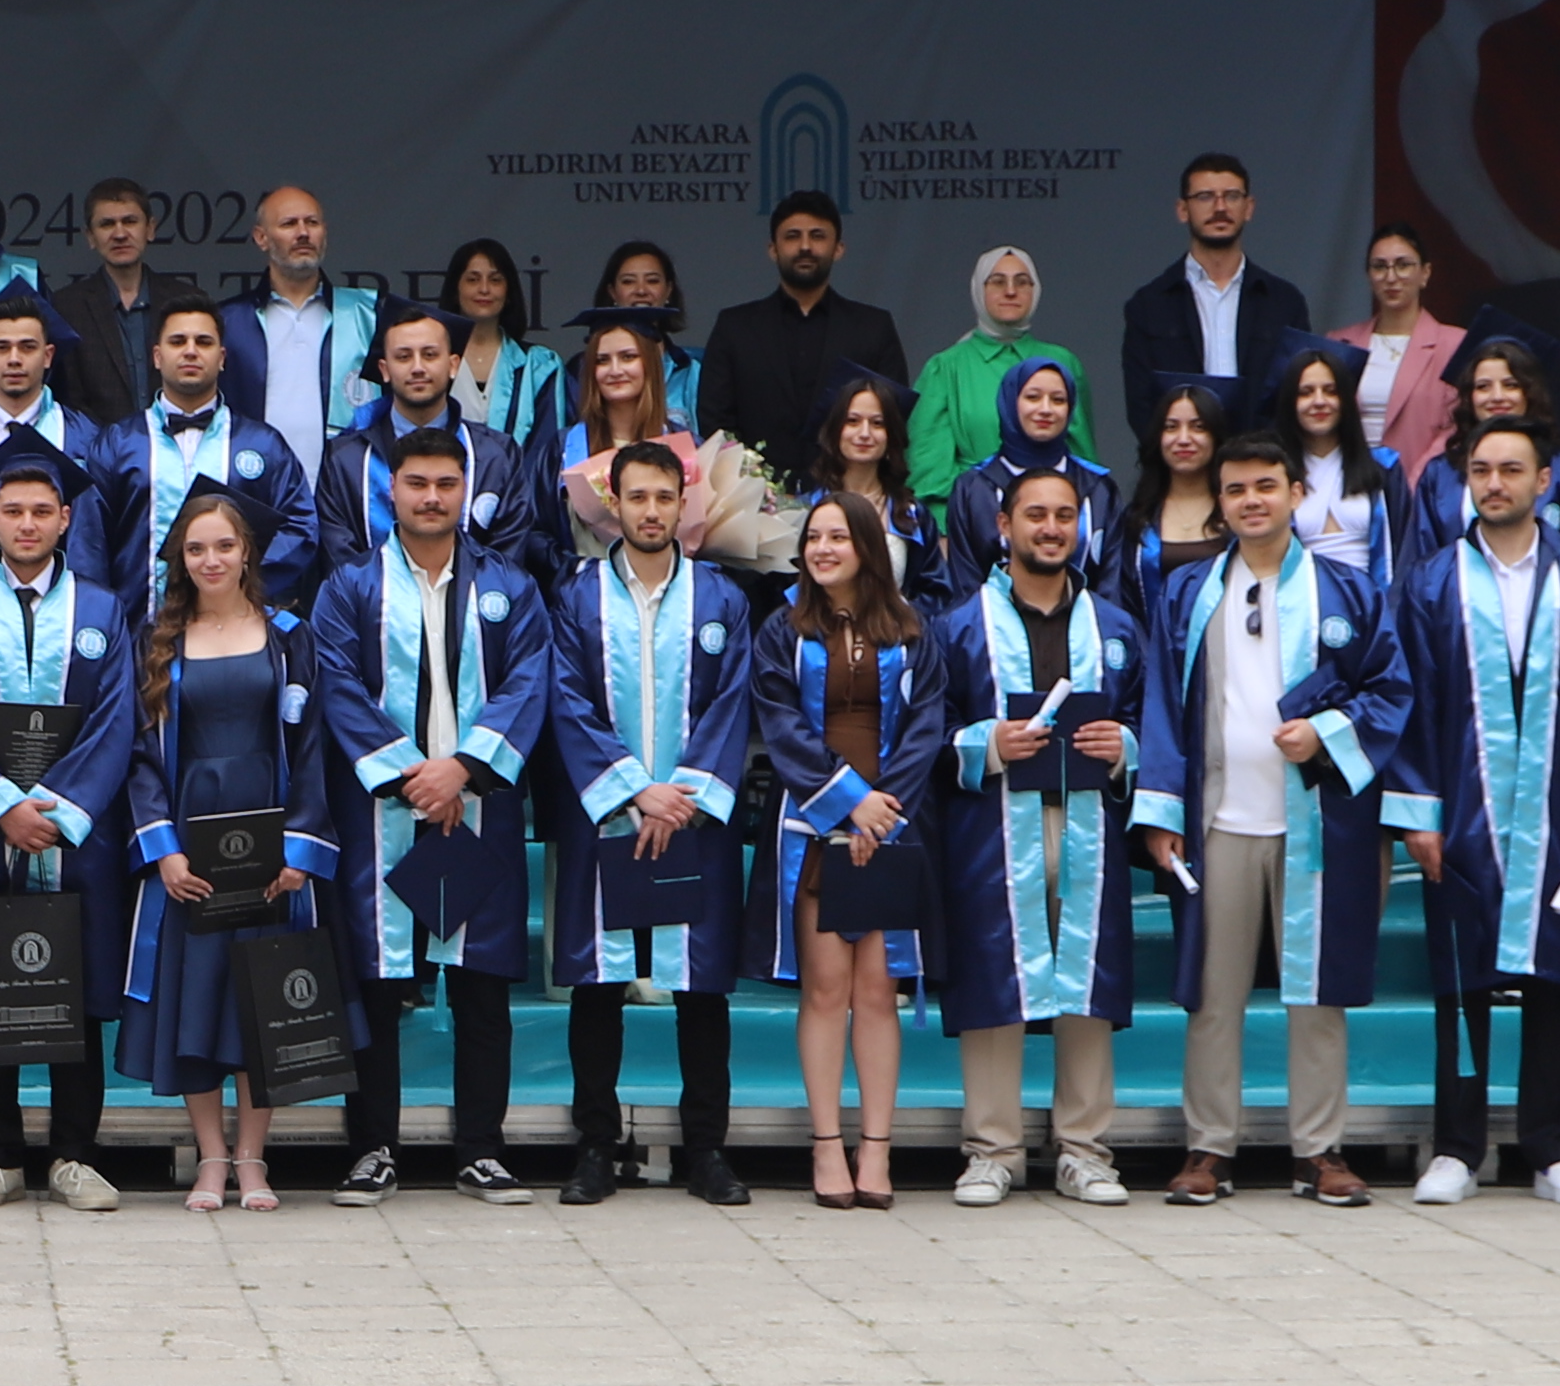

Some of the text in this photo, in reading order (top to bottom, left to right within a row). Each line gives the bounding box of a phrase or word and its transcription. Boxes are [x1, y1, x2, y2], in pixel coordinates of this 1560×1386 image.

[631, 124, 750, 145] ANKARA
[859, 121, 977, 143] ANKARA
[486, 152, 752, 175] YILDIRIM BEYAZIT
[859, 149, 1121, 172] YILDIRIM BEYAZIT
[573, 180, 750, 203] UNIVERSITY
[859, 175, 1060, 201] ÜNİVERSİTESİ
